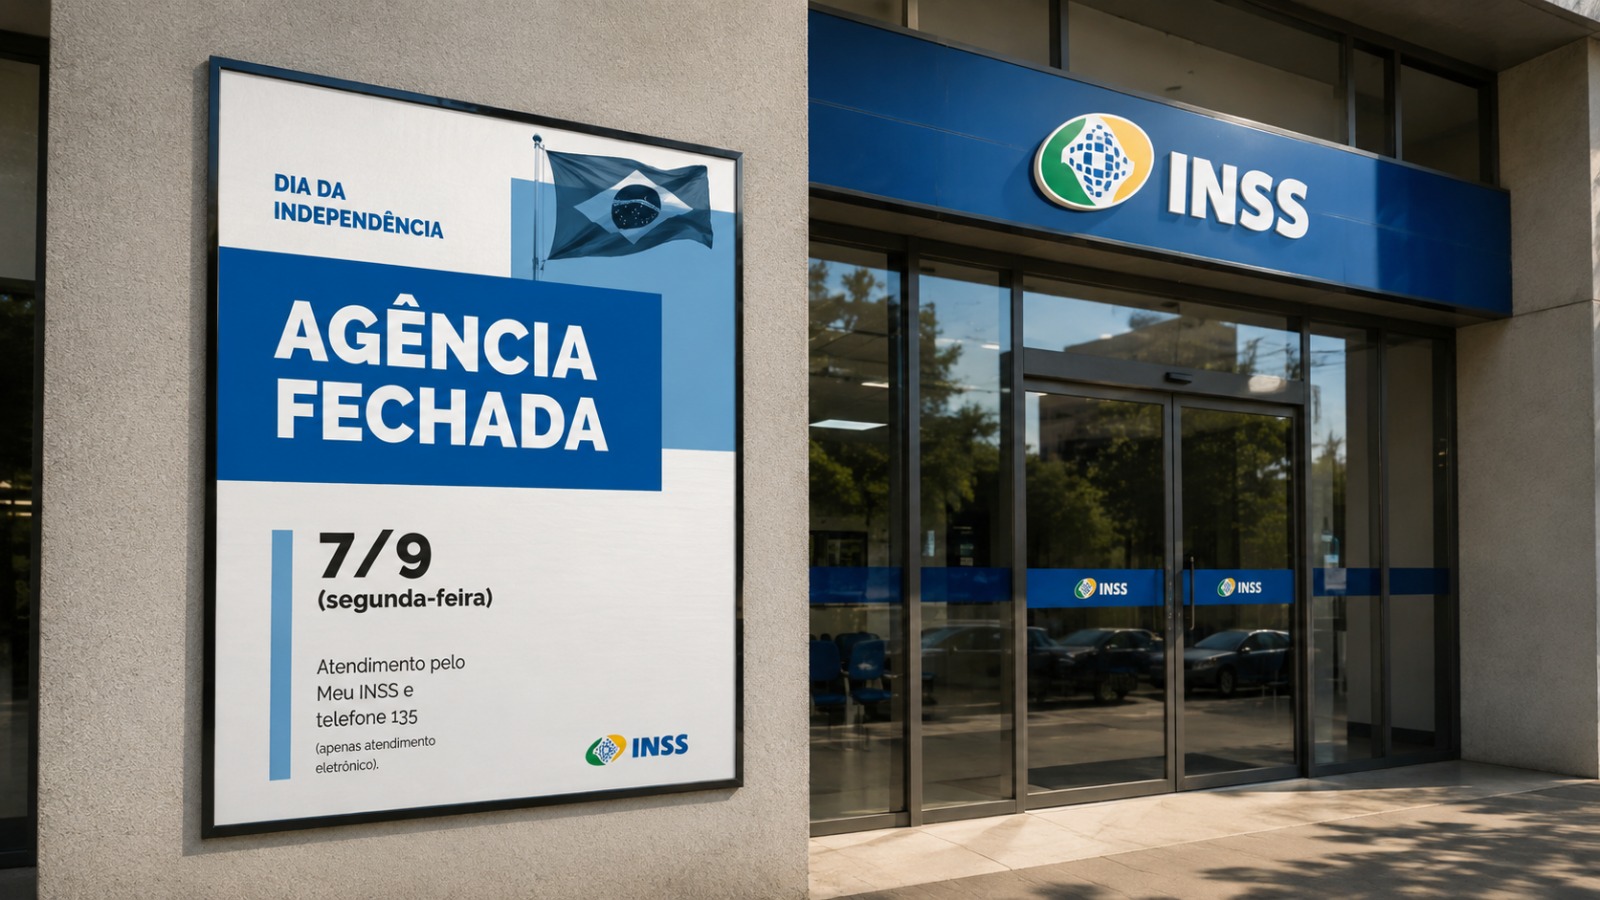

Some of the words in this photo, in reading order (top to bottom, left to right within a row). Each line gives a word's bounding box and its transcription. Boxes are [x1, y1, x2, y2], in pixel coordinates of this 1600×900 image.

[274, 173, 311, 196] DIA
[317, 179, 346, 201] DA
[1168, 150, 1310, 240] INSS
[274, 201, 444, 239] INDEPENDÊNCIA
[273, 293, 598, 381] AGÊNCIA
[276, 378, 609, 452] FECHADA
[319, 529, 432, 580] 7/9
[317, 587, 493, 614] (segunda-feira)
[1099, 582, 1128, 596] INSS
[1237, 581, 1262, 594] INSS
[316, 656, 426, 675] Atendimento
[430, 654, 466, 674] pelo
[317, 685, 354, 702] Meu
[359, 682, 399, 700] INSS
[403, 685, 414, 698] e
[316, 709, 388, 729] telefone
[391, 709, 418, 726] 135
[315, 742, 362, 757] (apenas
[364, 735, 436, 751] atendimento
[632, 733, 689, 758] INSS
